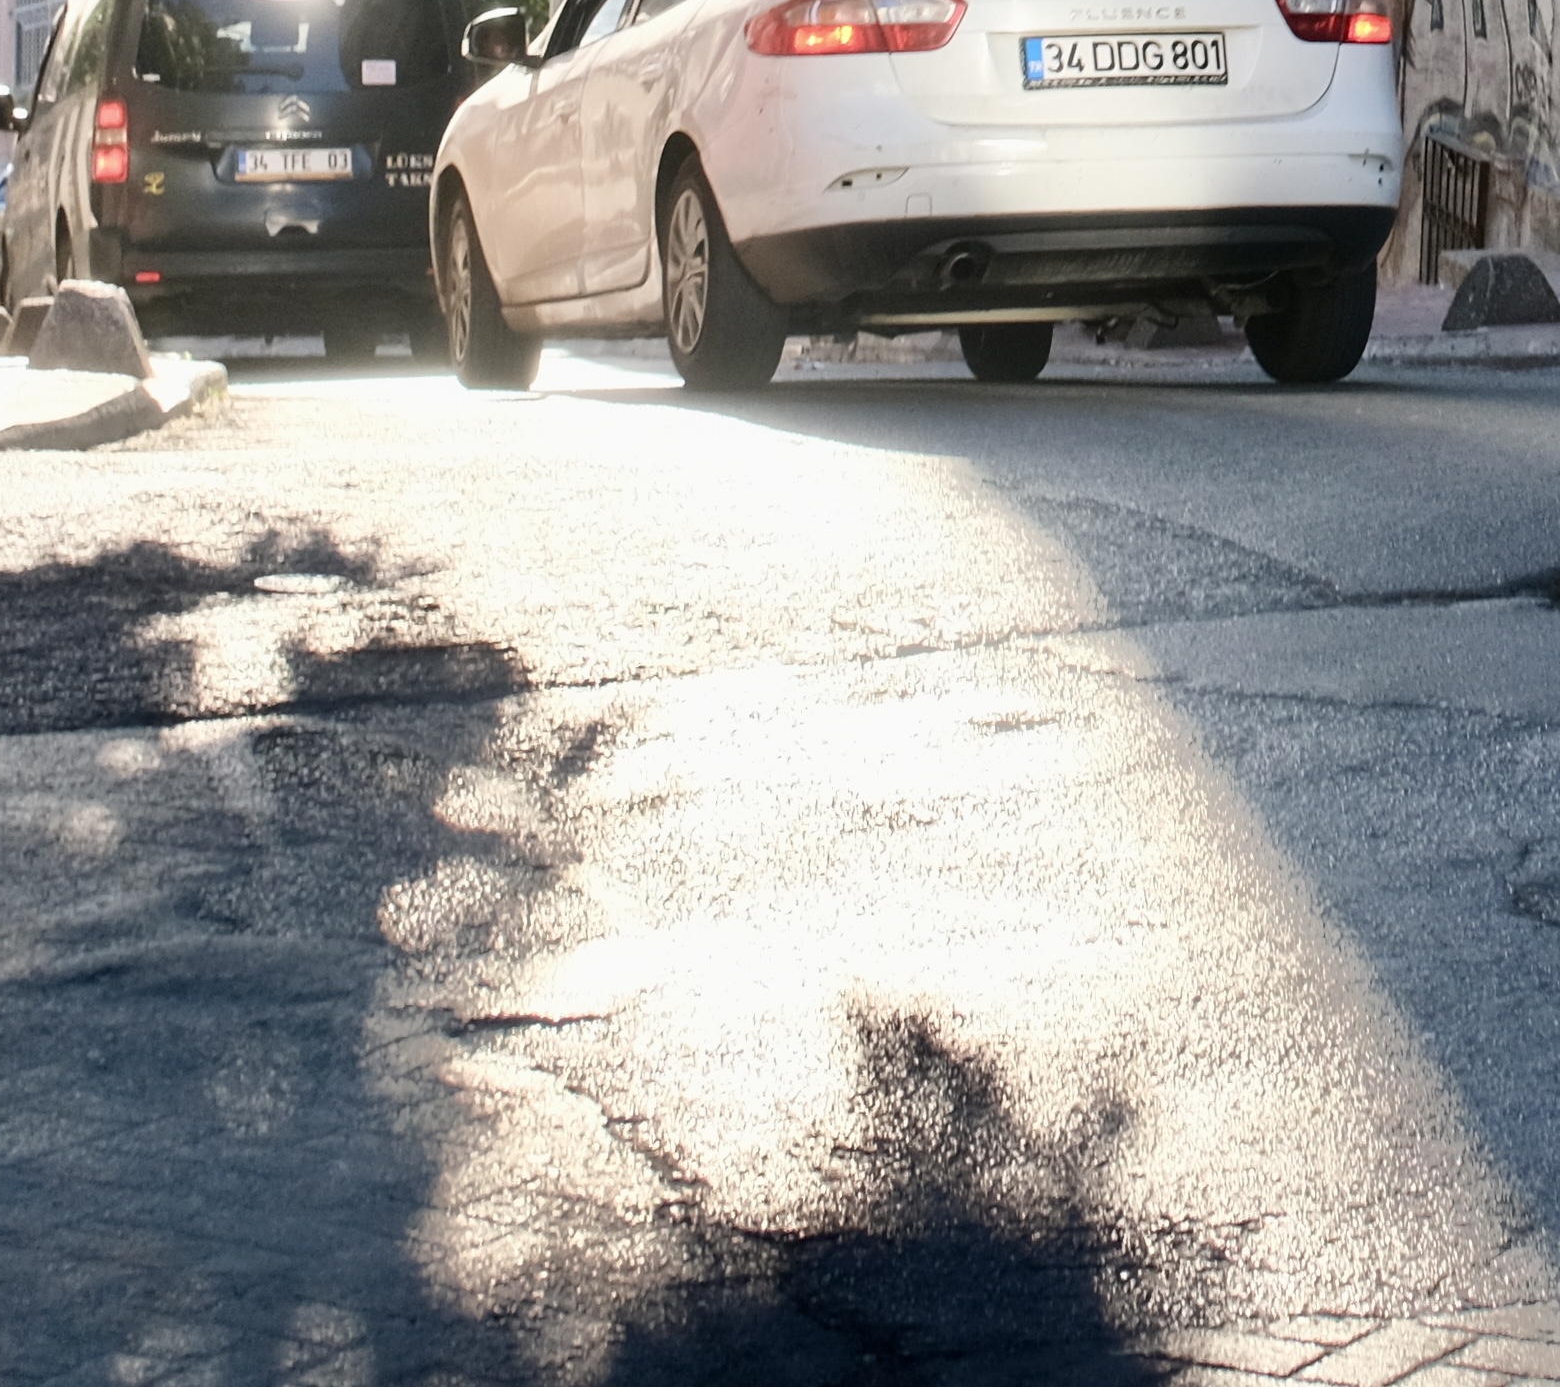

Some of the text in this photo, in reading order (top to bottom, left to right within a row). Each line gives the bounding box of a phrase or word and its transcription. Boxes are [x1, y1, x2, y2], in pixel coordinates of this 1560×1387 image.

[1070, 6, 1187, 22] FLUENCE
[1045, 41, 1085, 73] 34
[1092, 40, 1164, 72] DDG
[1171, 38, 1223, 71] 801
